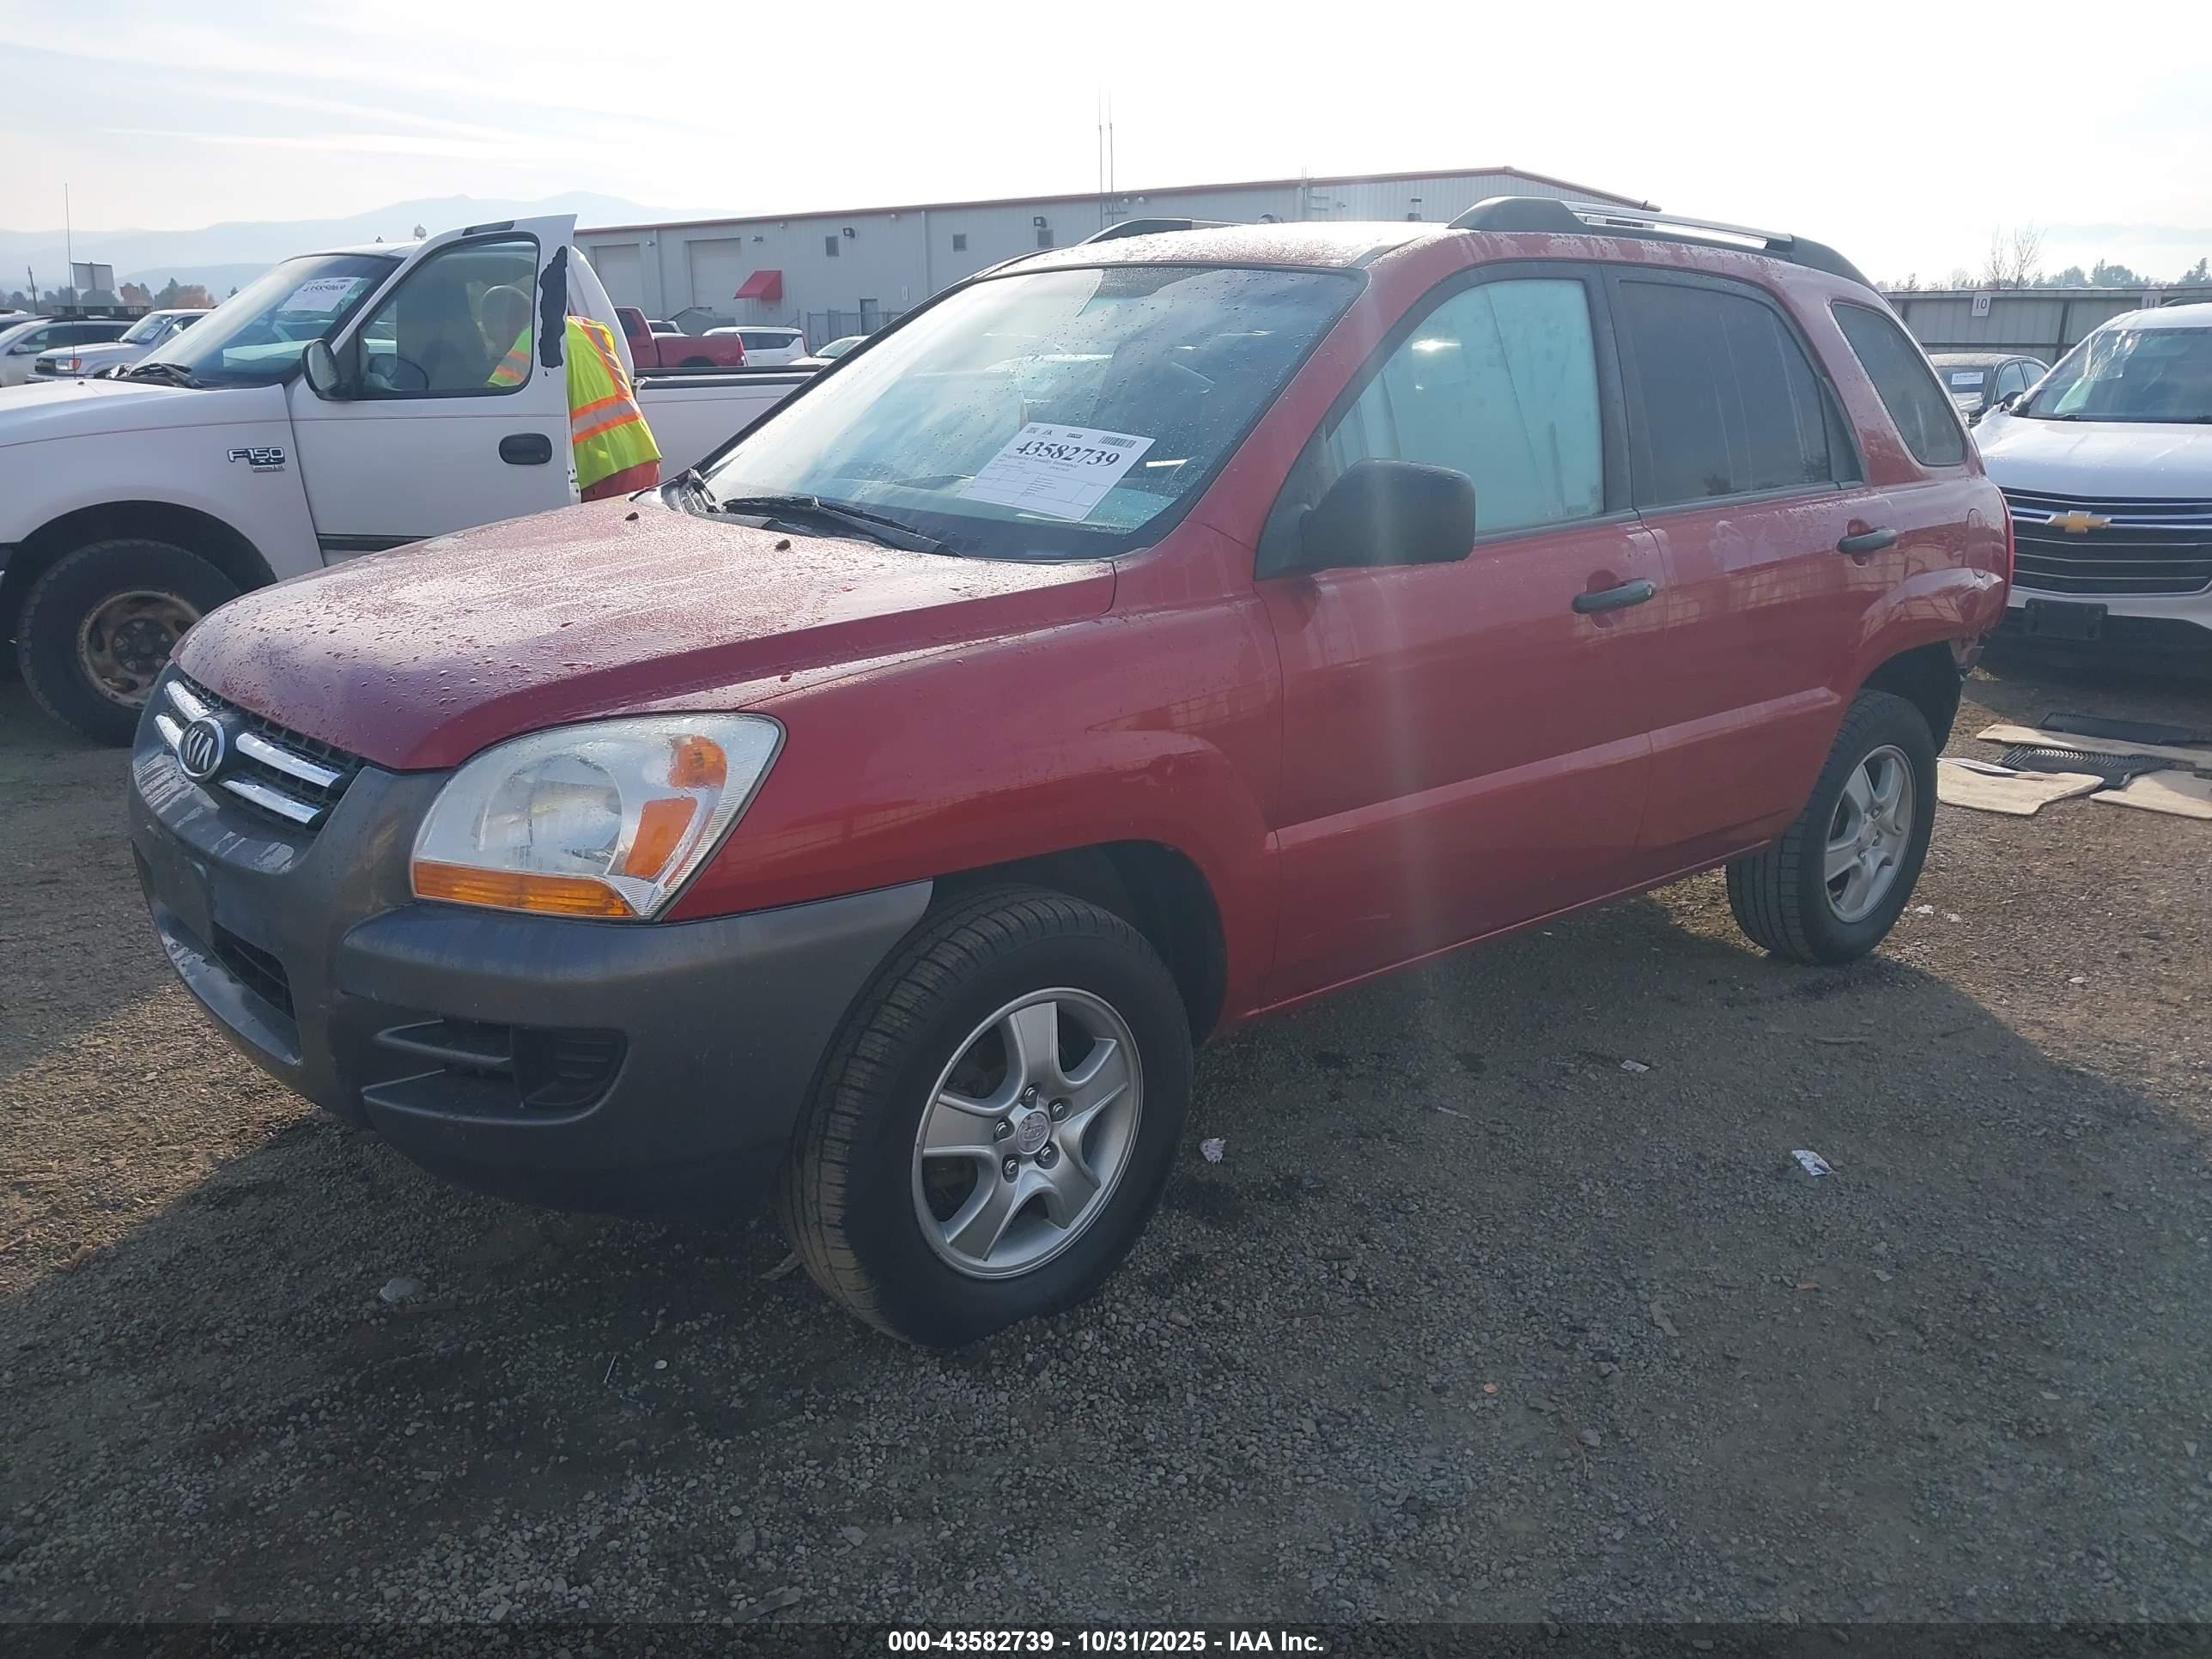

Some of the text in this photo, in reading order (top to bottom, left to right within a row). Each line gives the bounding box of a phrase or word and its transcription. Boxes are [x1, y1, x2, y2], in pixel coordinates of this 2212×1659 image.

[1976, 298, 1987, 310] 10
[1016, 441, 1120, 467] 43582739
[186, 726, 214, 771] KIA
